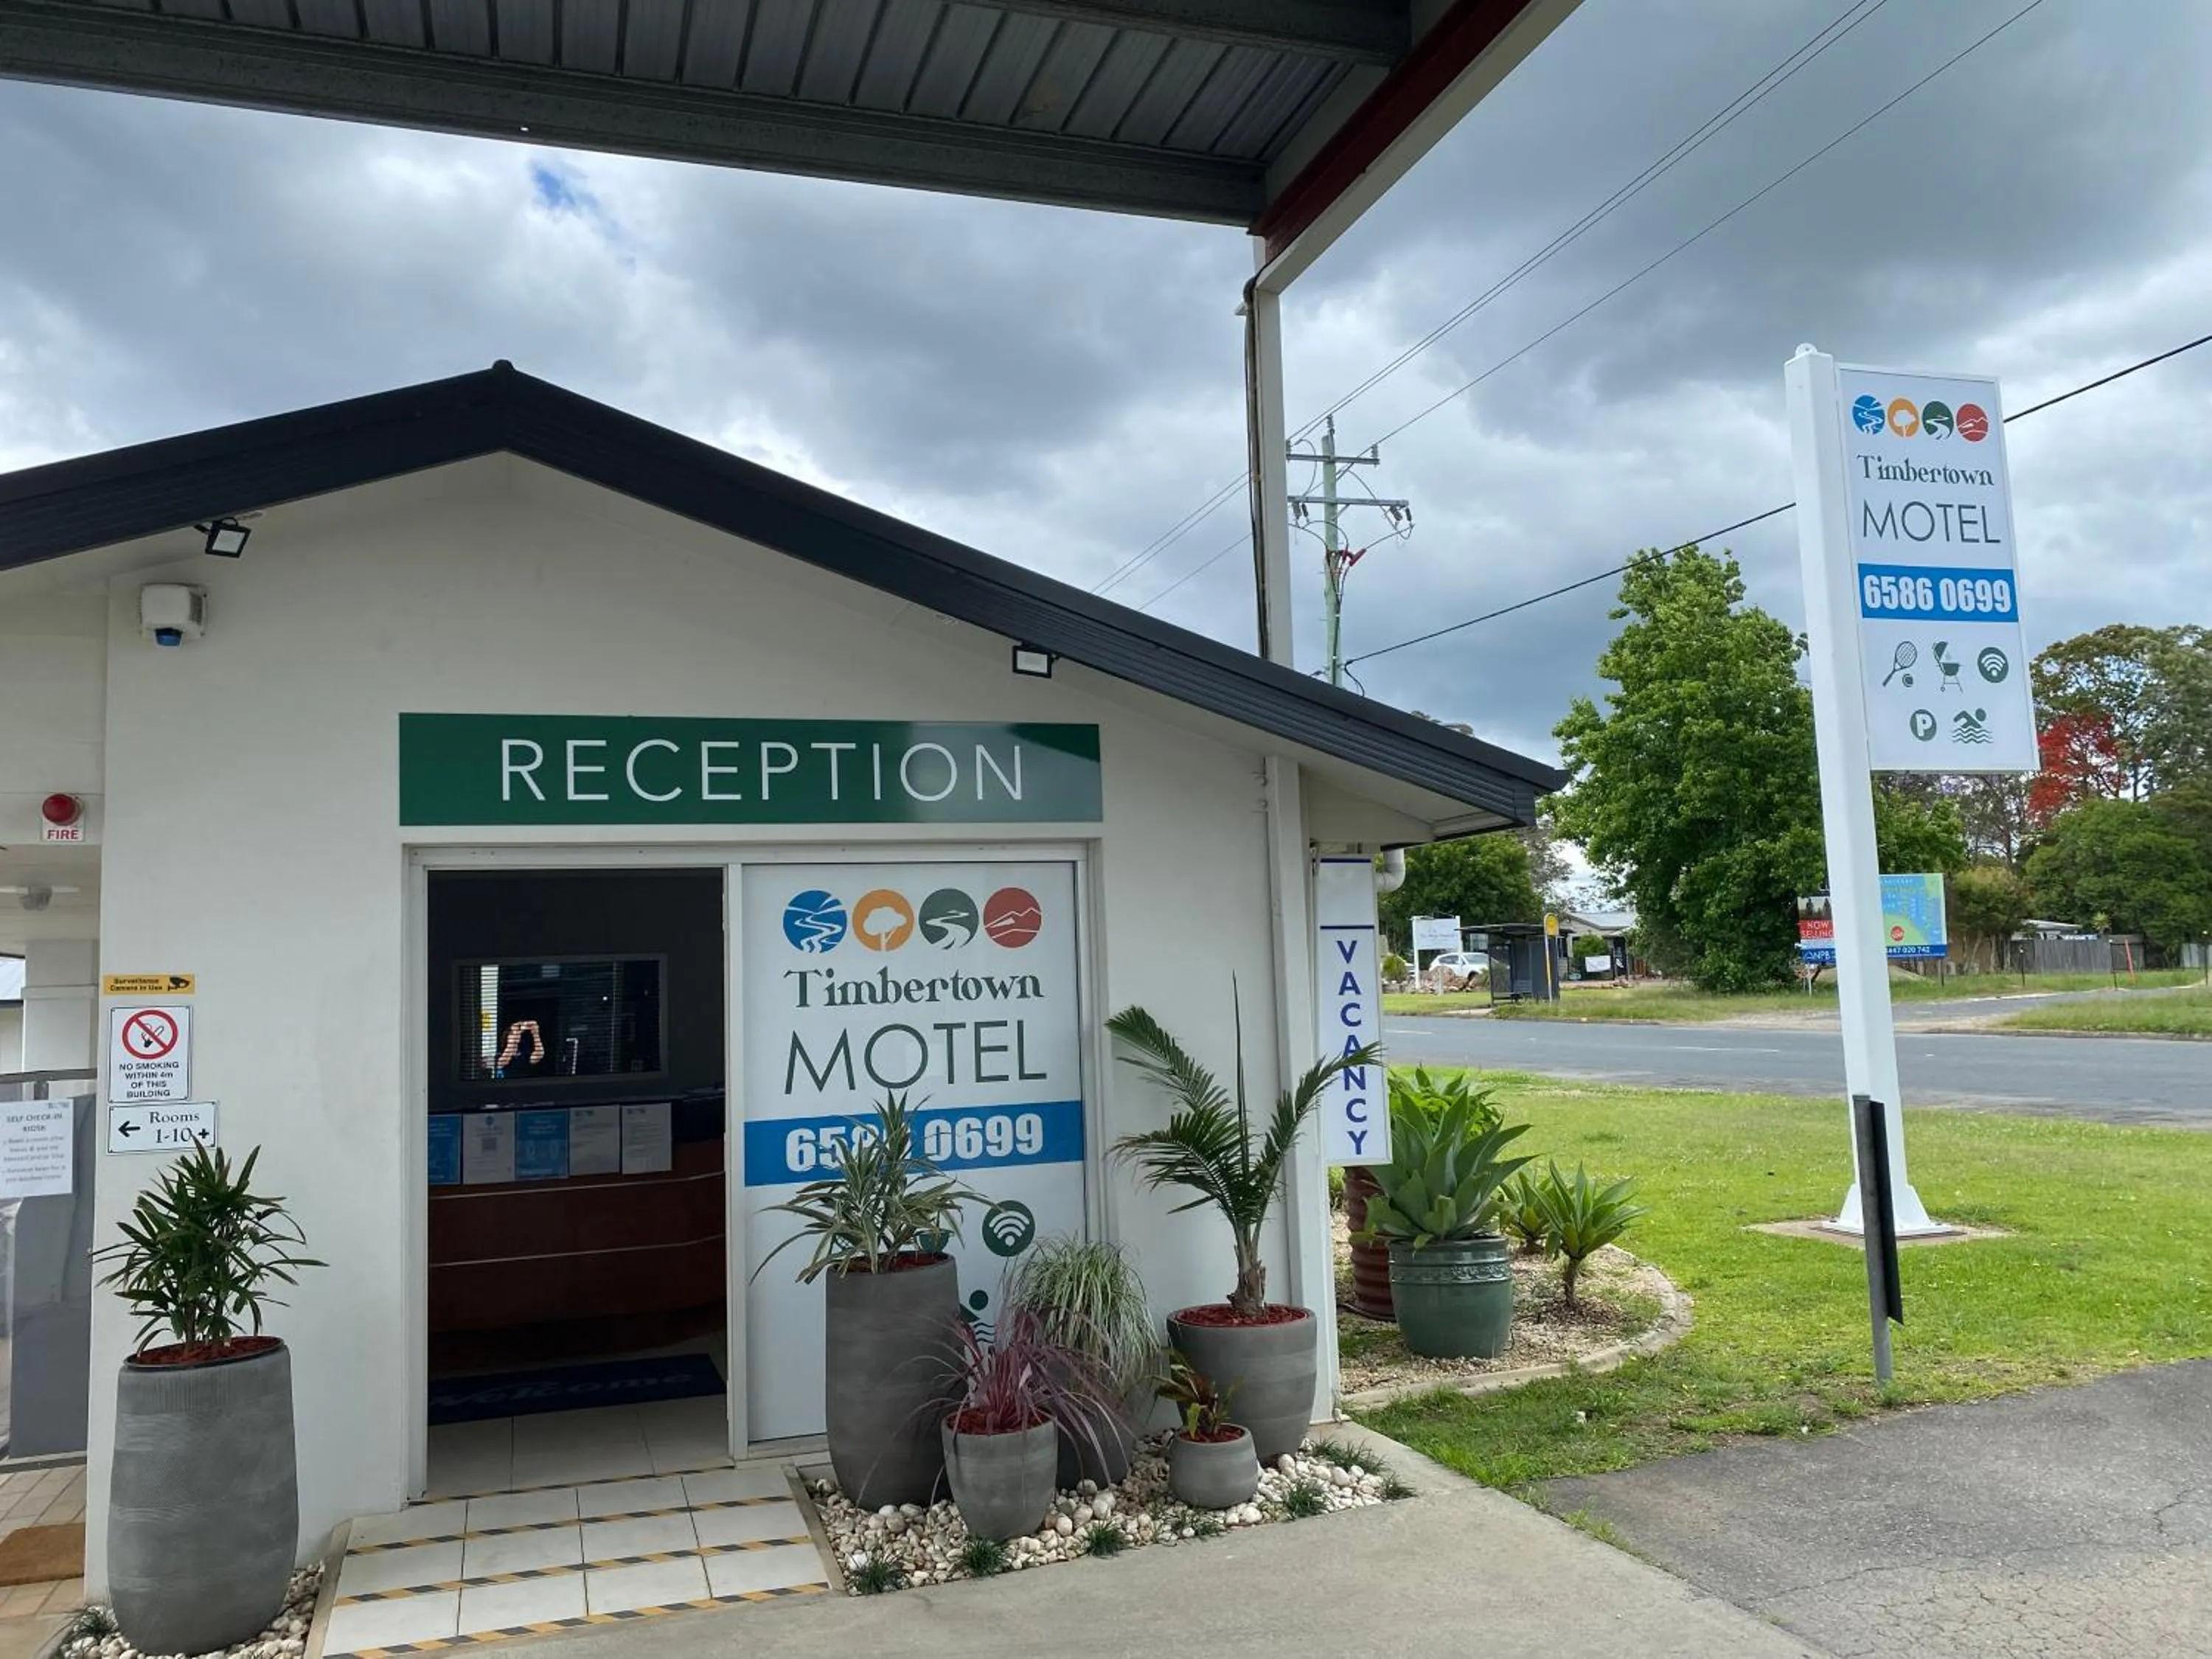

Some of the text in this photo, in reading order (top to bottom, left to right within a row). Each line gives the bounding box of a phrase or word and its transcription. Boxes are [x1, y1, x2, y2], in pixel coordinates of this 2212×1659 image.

[1857, 453, 1994, 486] Timbertown
[1863, 498, 2001, 543] MOTEL
[1863, 574, 2012, 613] 6586 0699
[501, 739, 1022, 802] RECEPTION
[46, 830, 79, 840] FIRE
[1806, 921, 1829, 930] NOW
[784, 966, 1045, 1008] Timbertown
[135, 1061, 179, 1070] SMOKING
[785, 1020, 1047, 1095] MOTEL
[1337, 940, 1368, 1155] VACANCY
[126, 1090, 170, 1099] BUILDING
[150, 1110, 200, 1124] Rooms
[786, 1113, 1043, 1172] 658 0699
